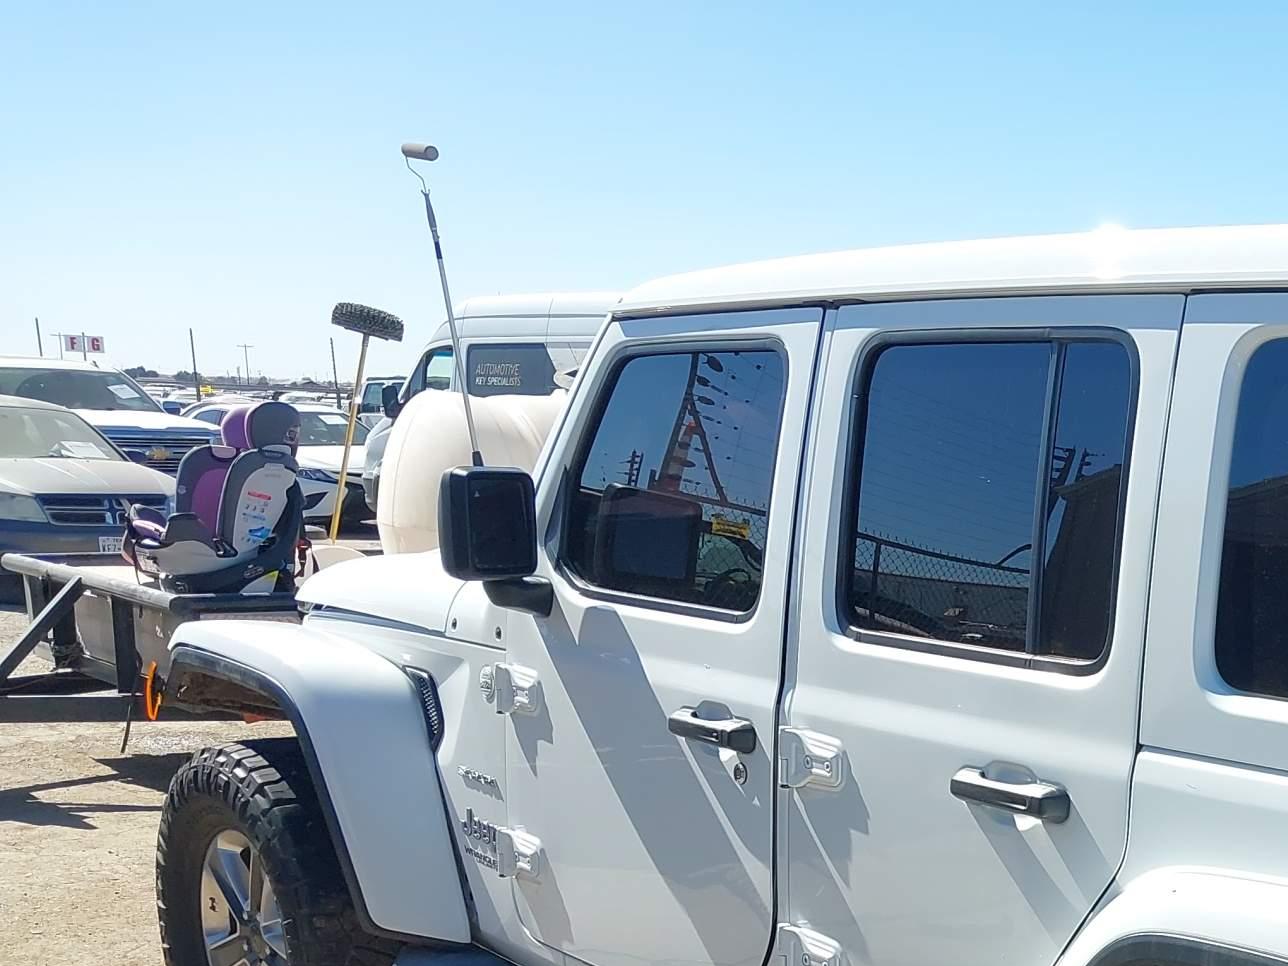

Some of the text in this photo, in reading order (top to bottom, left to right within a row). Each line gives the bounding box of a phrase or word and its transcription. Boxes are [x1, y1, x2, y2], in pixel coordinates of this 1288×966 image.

[69, 336, 77, 350] F
[91, 337, 101, 351] G
[475, 363, 521, 376] AUTOMOTIVE
[475, 376, 521, 386] KEY SPECIALISTS
